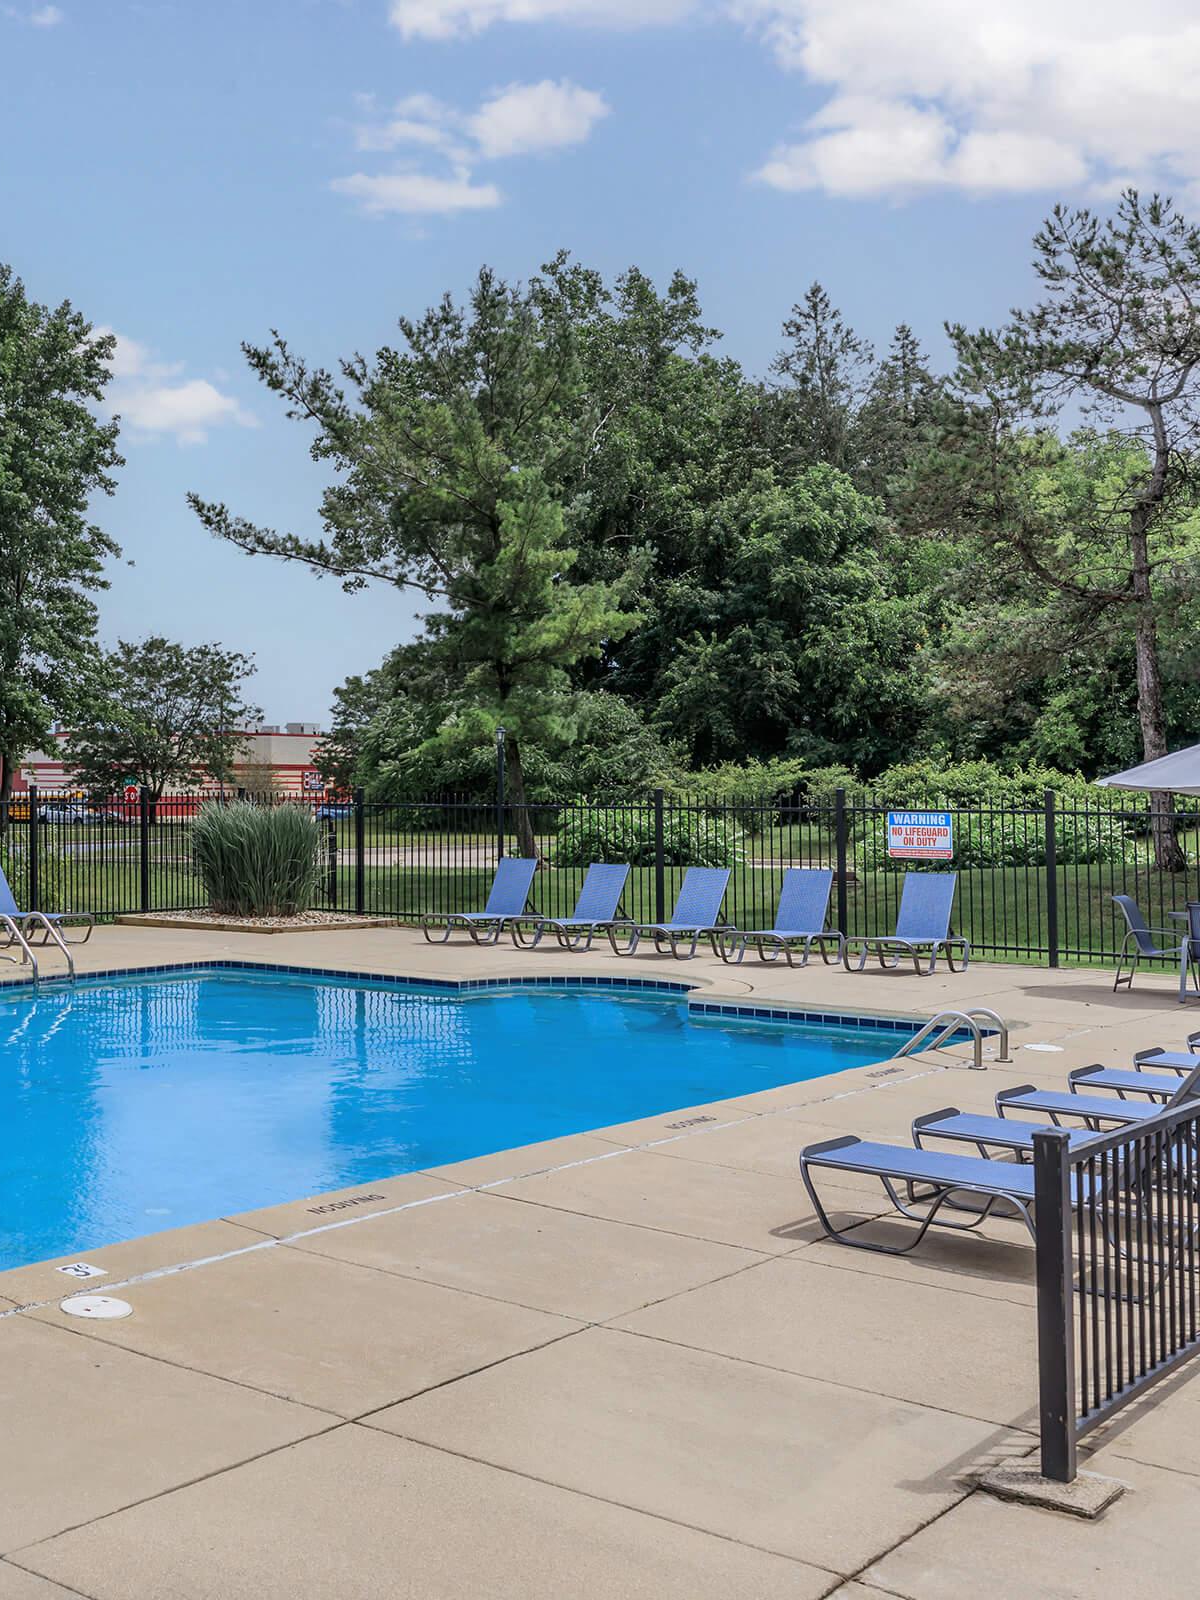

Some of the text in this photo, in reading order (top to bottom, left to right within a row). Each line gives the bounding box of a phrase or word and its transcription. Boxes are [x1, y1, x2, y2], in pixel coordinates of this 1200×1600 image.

[893, 814, 946, 825] WARNING
[891, 827, 949, 837] NO LIFEGUARD
[903, 837, 937, 846] ON DUTY
[306, 1193, 387, 1215] NO DIVING
